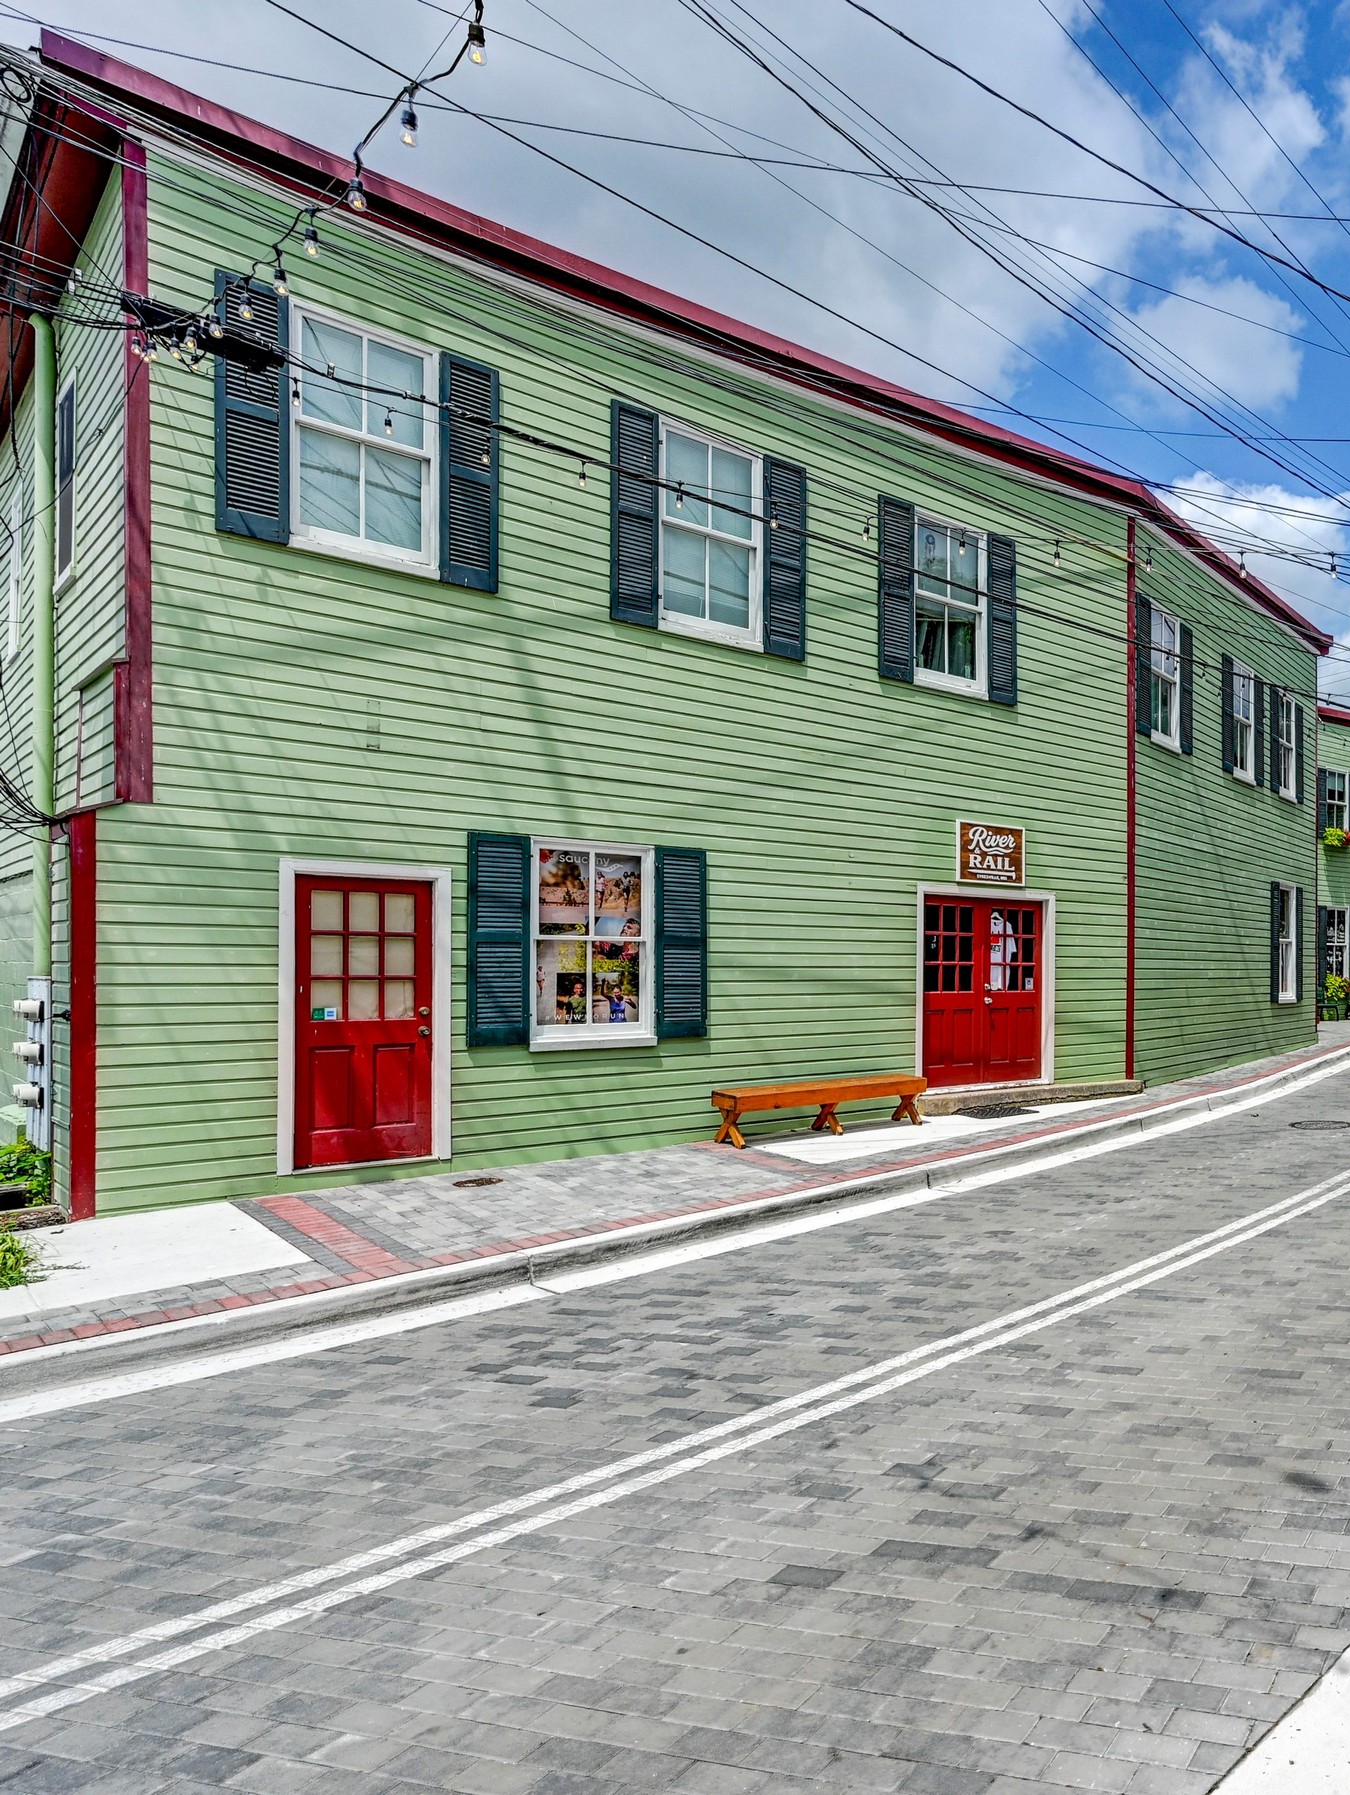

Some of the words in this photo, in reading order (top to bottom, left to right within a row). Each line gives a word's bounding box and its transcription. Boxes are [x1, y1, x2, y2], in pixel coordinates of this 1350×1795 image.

[967, 826, 1016, 854] River
[558, 854, 610, 866] saucny
[968, 854, 1015, 871] RAIL
[544, 1012, 625, 1021] #WEWORUN
